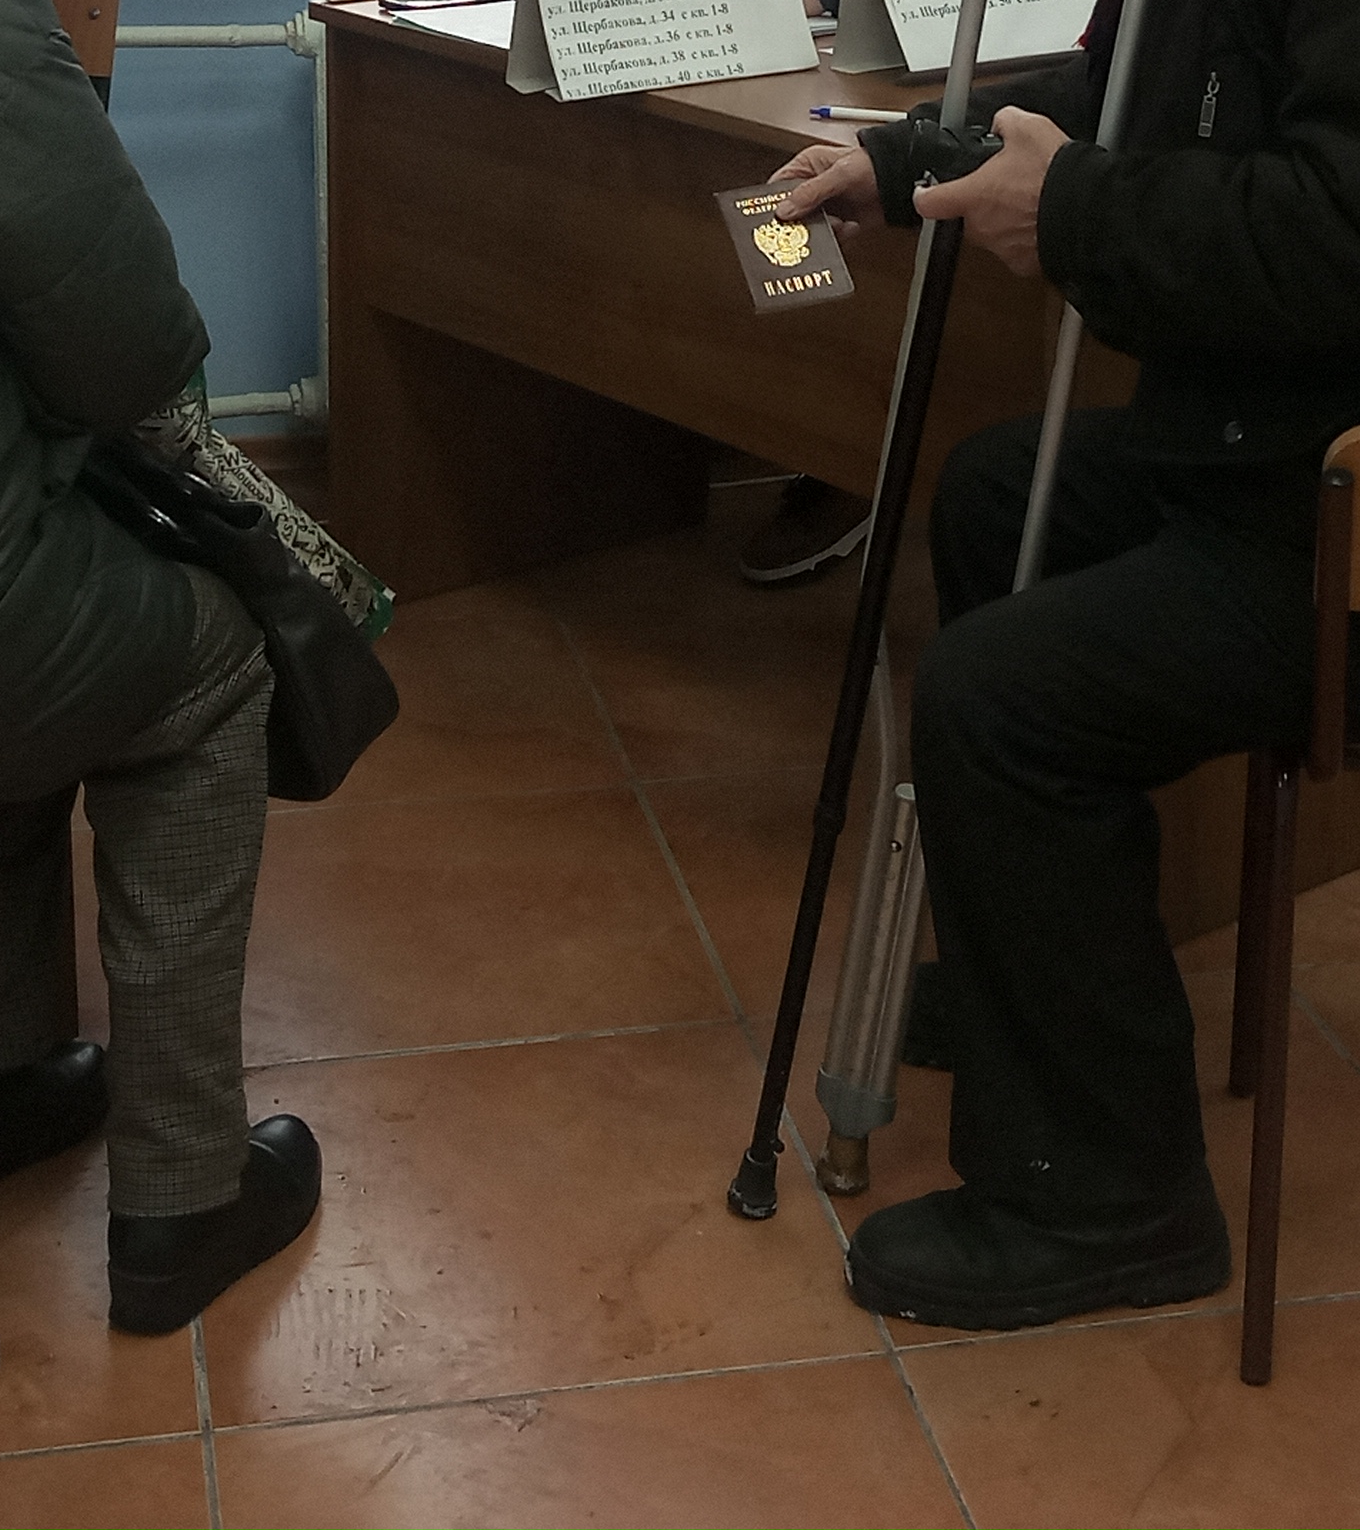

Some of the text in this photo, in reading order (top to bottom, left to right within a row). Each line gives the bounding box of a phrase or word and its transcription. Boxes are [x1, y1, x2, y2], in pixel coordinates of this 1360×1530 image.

[548, 5, 566, 19] ул.
[551, 27, 570, 40] ул.
[572, 18, 646, 35] Щербакова,
[681, 11, 687, 20] с
[712, 3, 729, 16] 1-8
[901, 10, 919, 23] ул.
[556, 47, 575, 60] ул.
[577, 38, 652, 55] Щербакова,
[666, 29, 680, 43] 36
[686, 31, 692, 40] с
[716, 23, 733, 36] 1-8
[561, 68, 581, 81] ул.
[583, 59, 657, 75] Щербакова,
[671, 50, 686, 63] 38
[691, 51, 697, 60] с
[721, 43, 738, 56] 1-8
[678, 70, 690, 83] 40
[697, 71, 703, 80] с
[726, 62, 744, 76] 1-8
[735, 191, 792, 209] РОССИЙСК
[764, 269, 833, 297] ПАСПОРТ
